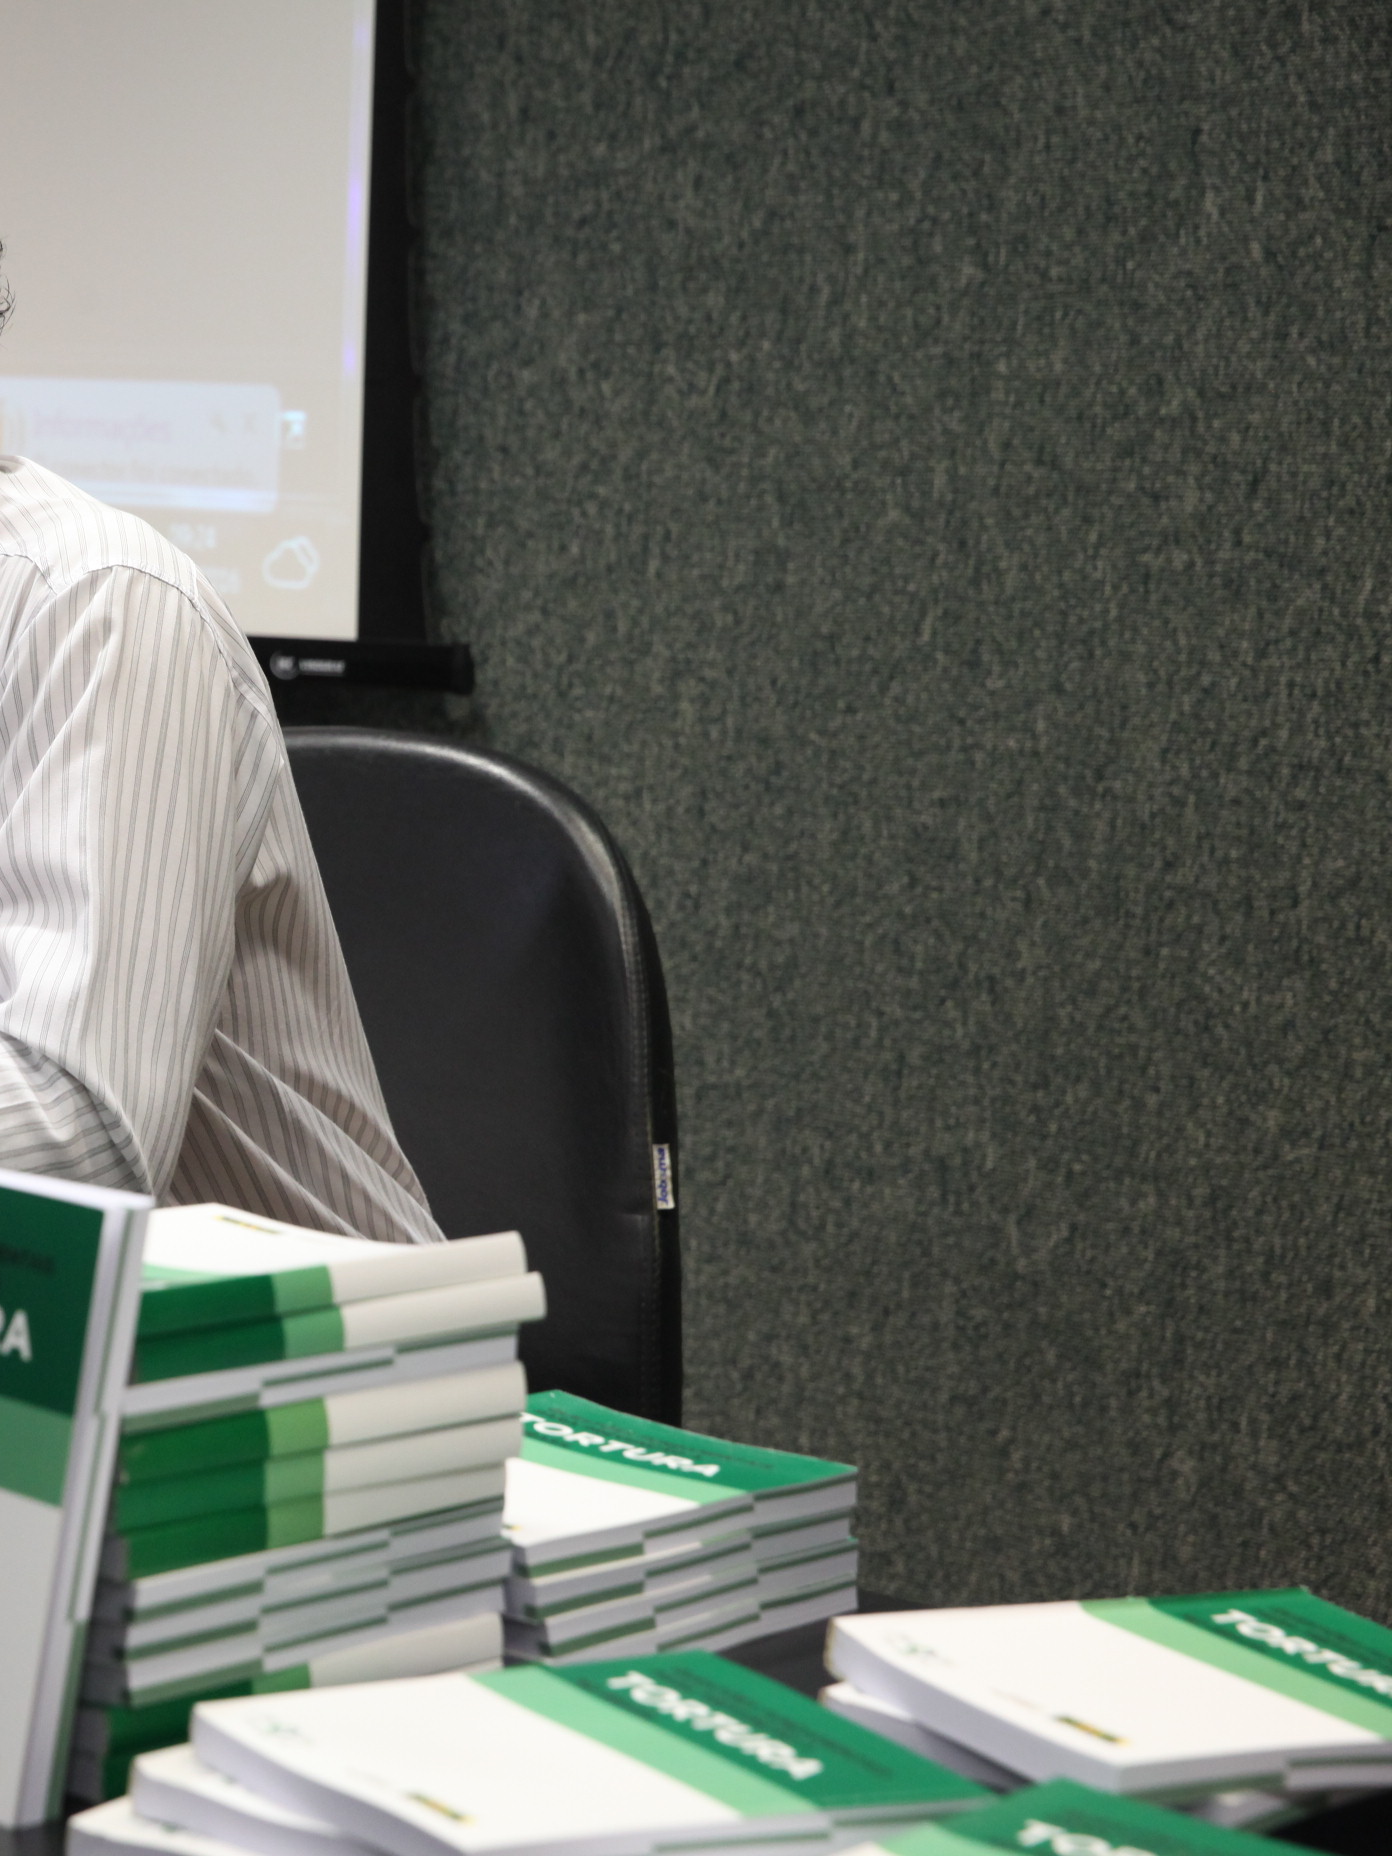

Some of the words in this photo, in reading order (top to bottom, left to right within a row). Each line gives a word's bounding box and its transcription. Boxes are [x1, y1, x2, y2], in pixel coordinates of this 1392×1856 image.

[519, 1411, 721, 1478] TORTURA
[1210, 1608, 1392, 1699] TORTUR
[605, 1669, 824, 1782] TORTURA
